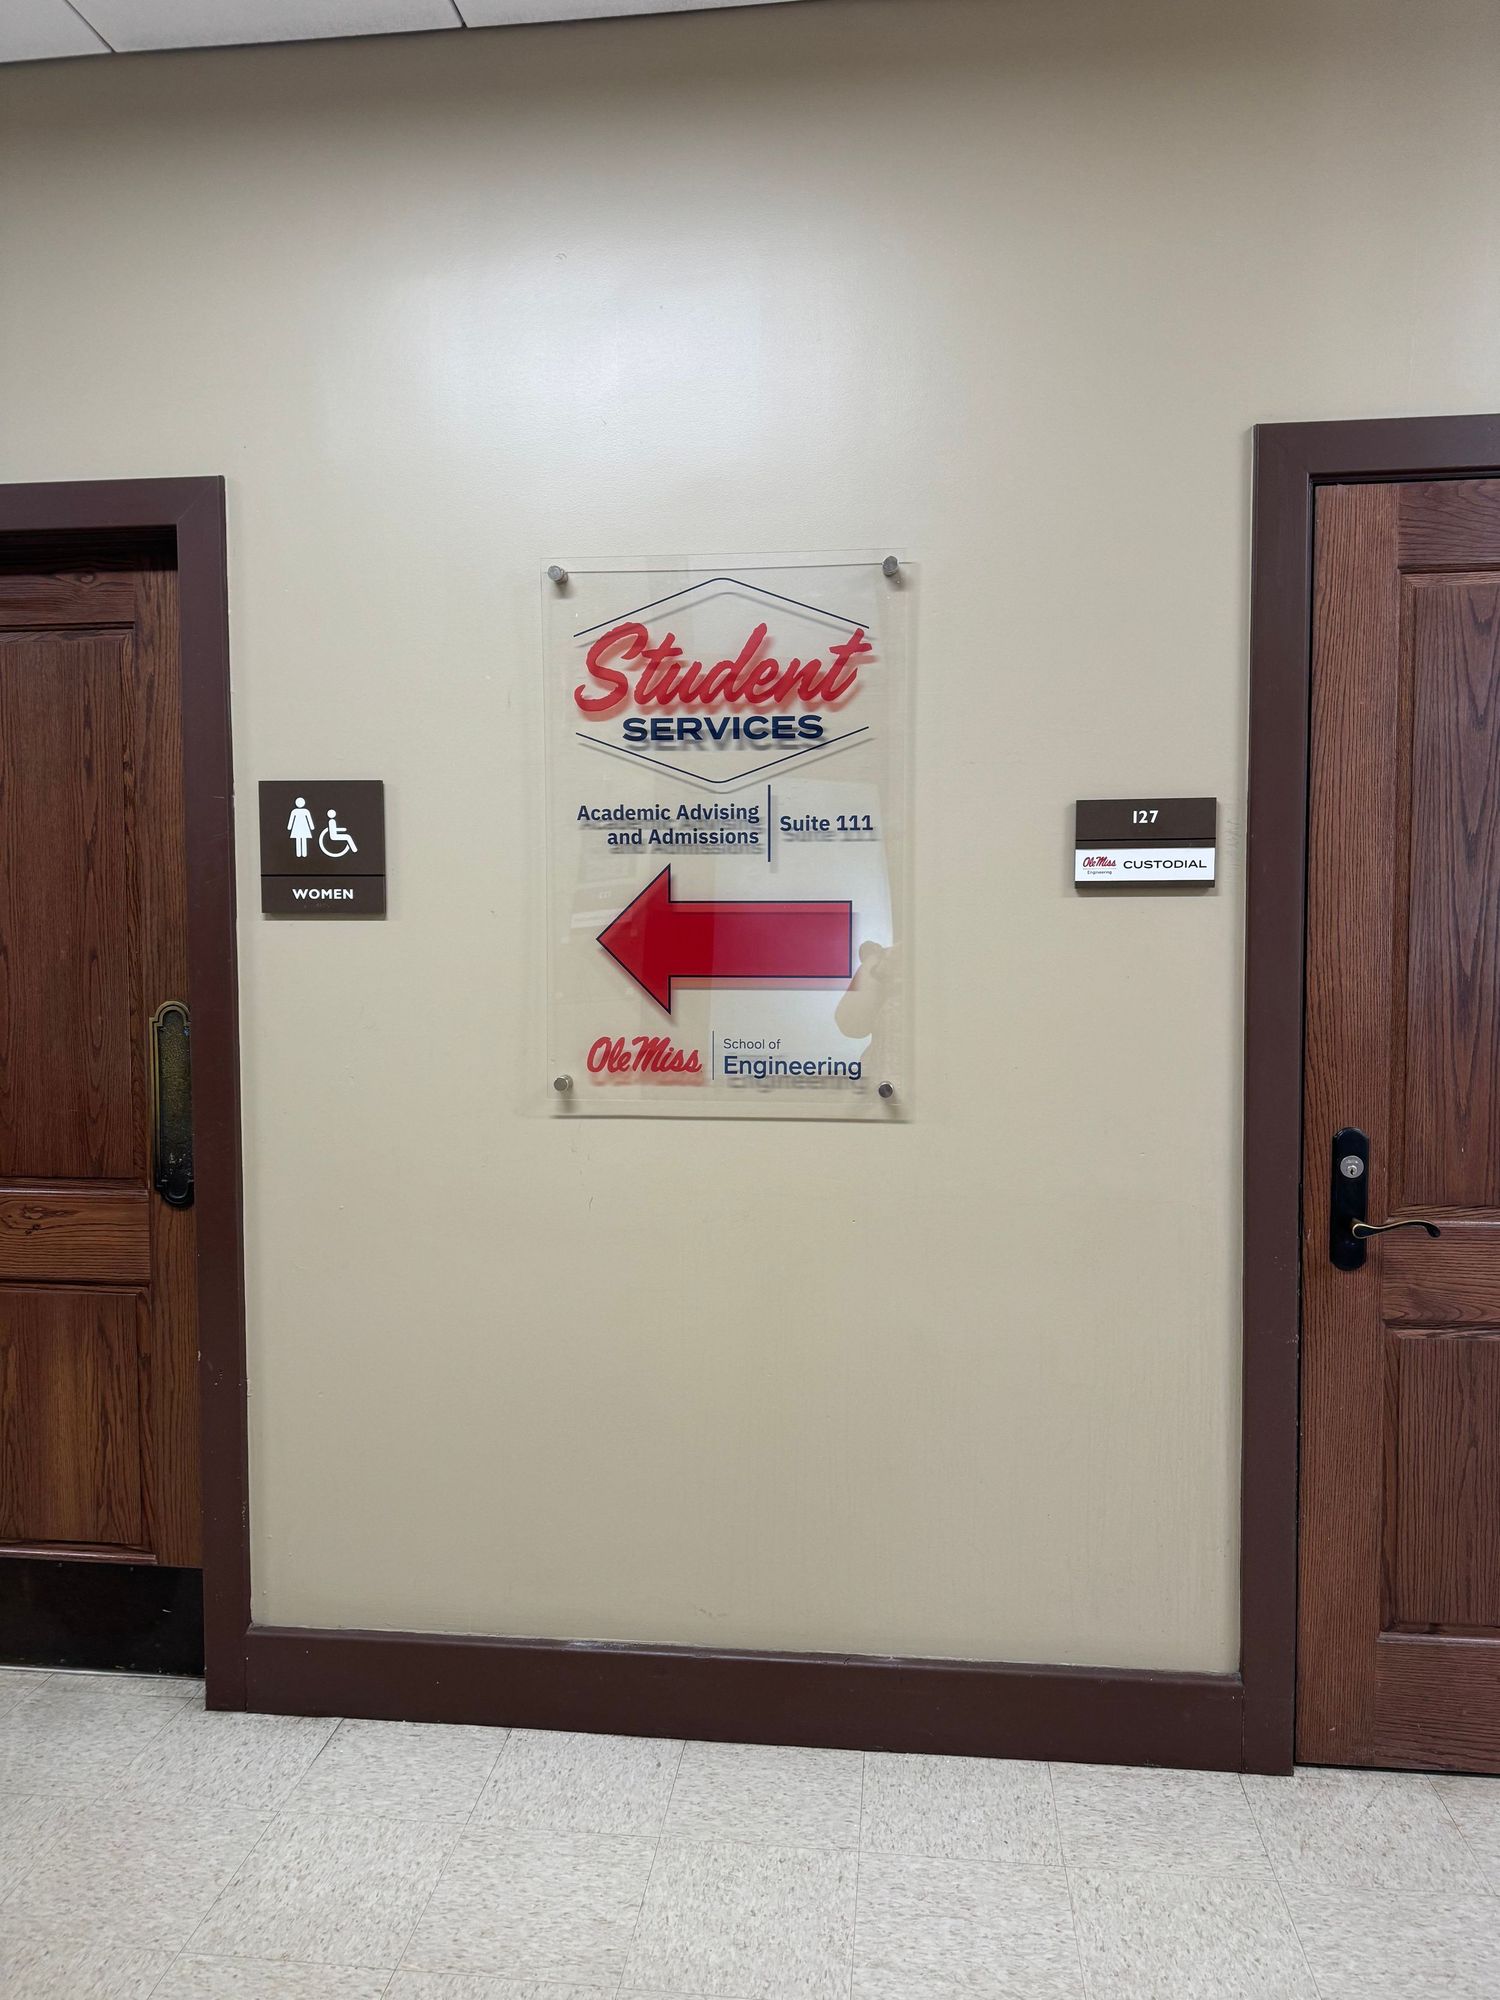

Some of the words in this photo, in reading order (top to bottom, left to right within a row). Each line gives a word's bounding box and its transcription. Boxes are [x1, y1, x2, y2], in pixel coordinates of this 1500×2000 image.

[574, 622, 873, 712] Student
[622, 714, 823, 741] SERVICES
[577, 804, 671, 821] Academic
[676, 803, 760, 824] Advising
[1132, 810, 1158, 823] 127
[779, 815, 830, 833] Suite
[836, 814, 873, 831] 111
[607, 829, 642, 845] and
[648, 828, 759, 845] Admissions
[1123, 860, 1207, 869] CUSTODIAL
[292, 888, 353, 900] WOMEN
[723, 1038, 765, 1050] School
[768, 1038, 781, 1050] of
[723, 1055, 862, 1080] Engineering
